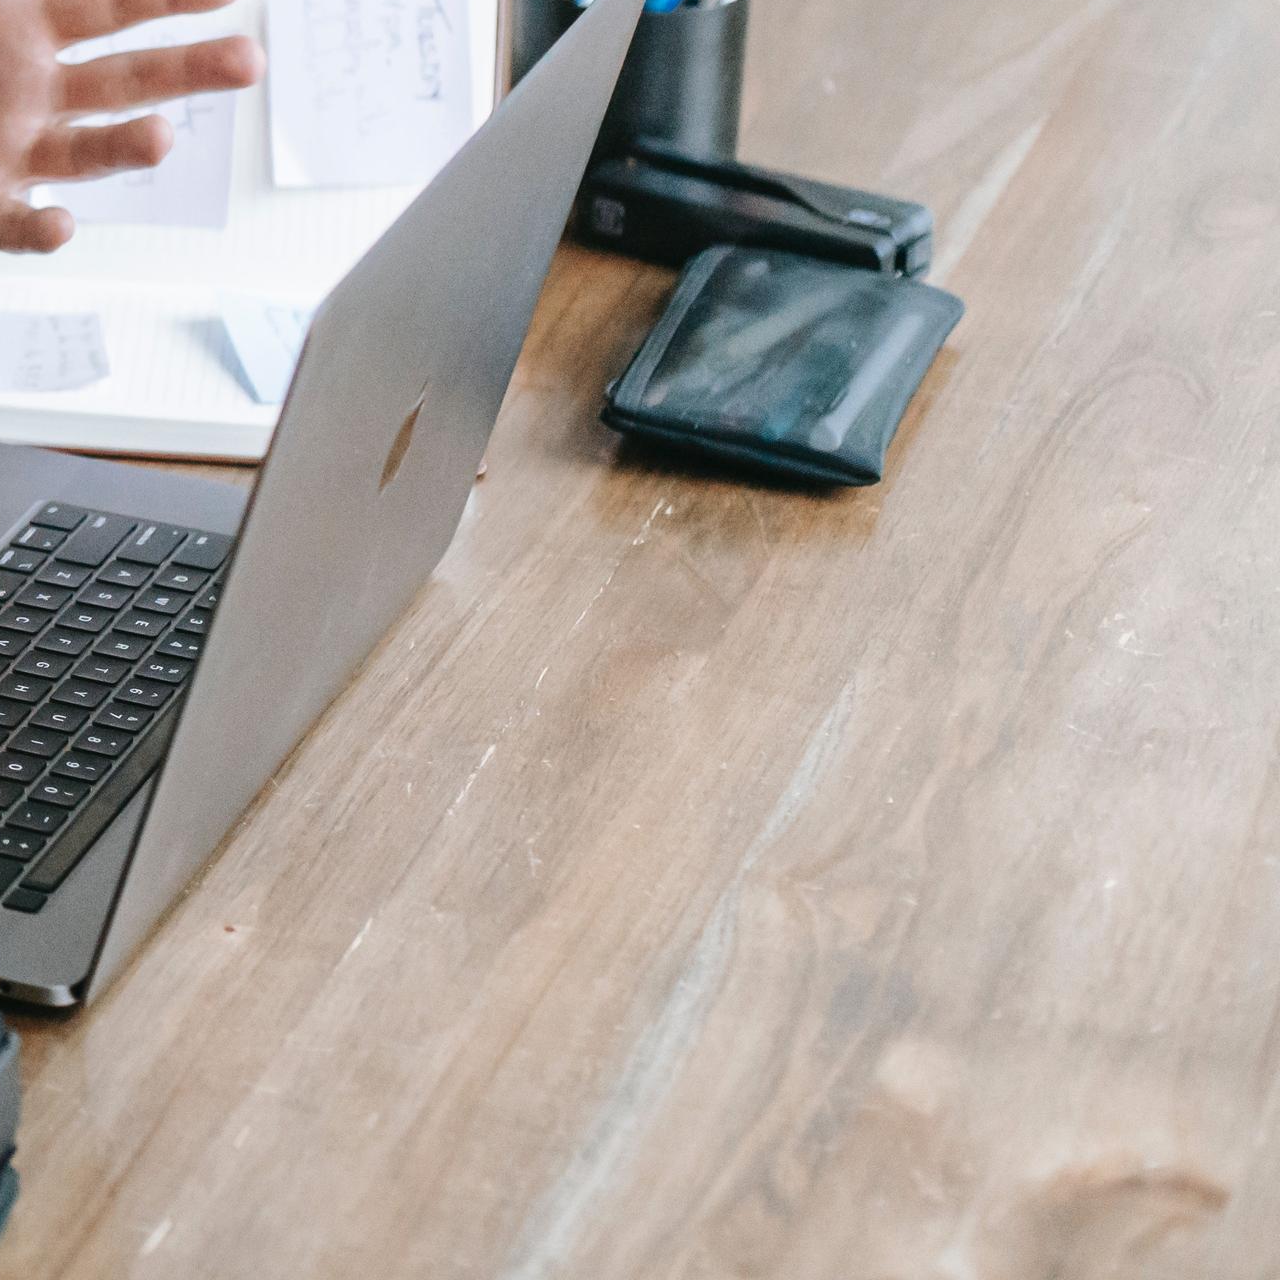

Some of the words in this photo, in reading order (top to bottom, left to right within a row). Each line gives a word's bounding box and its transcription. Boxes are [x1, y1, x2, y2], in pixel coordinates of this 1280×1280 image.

[56, 571, 72, 579] Z
[172, 575, 189, 583] Q
[35, 593, 52, 601] X
[98, 592, 113, 600] S
[154, 597, 170, 606] W
[15, 616, 30, 624] C
[134, 620, 150, 628] E
[36, 661, 50, 669] G
[14, 684, 30, 693] H
[52, 714, 67, 722] U
[87, 736, 102, 744] 8
